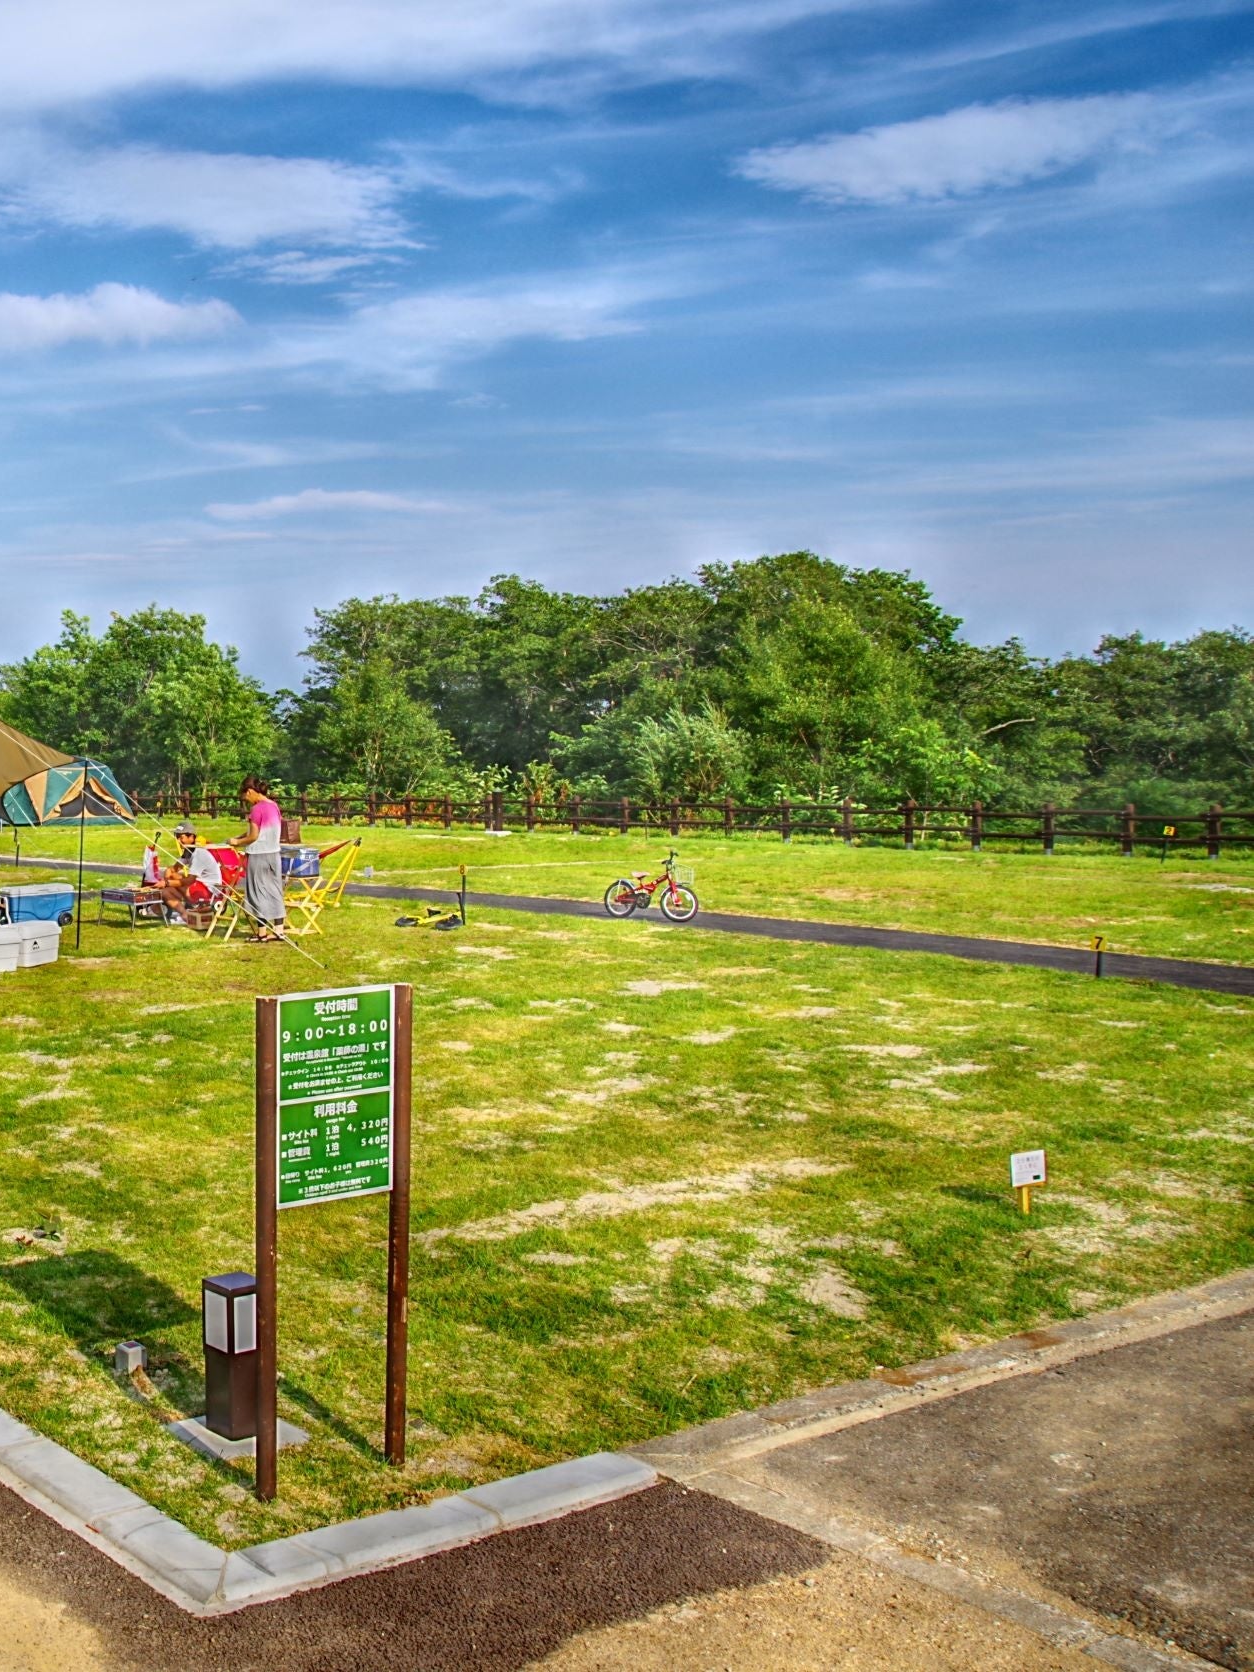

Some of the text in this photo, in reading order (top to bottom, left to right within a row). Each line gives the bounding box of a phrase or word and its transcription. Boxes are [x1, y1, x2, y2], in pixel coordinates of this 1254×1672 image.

[459, 864, 465, 875] 8
[1094, 936, 1103, 949] 7
[314, 998, 358, 1016] 受付時間
[313, 1100, 358, 1118] 利用料金
[360, 1134, 389, 1147] 540円
